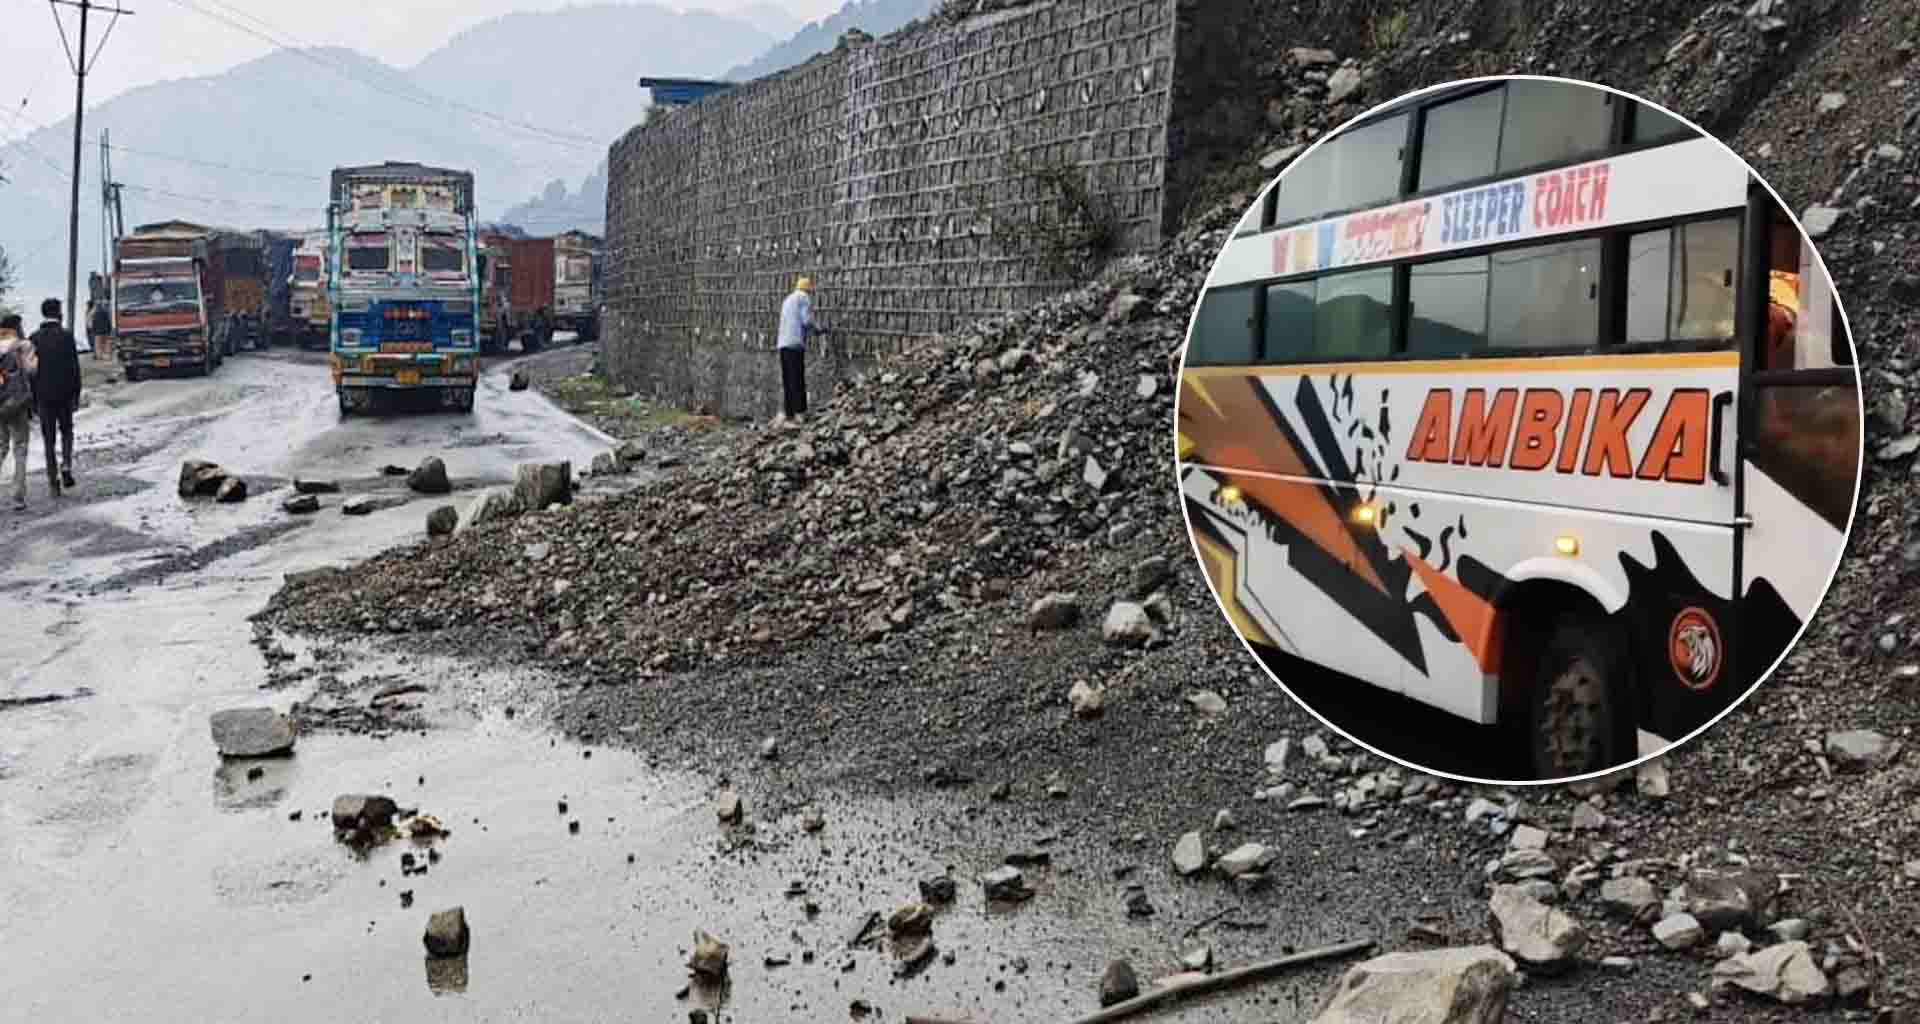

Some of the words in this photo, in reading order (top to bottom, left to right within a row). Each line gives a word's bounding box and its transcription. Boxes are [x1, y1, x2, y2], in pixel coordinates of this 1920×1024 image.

[1440, 181, 1525, 244] SLEEPER
[1533, 163, 1609, 232] COACH
[1406, 387, 1711, 484] AMBIKA
